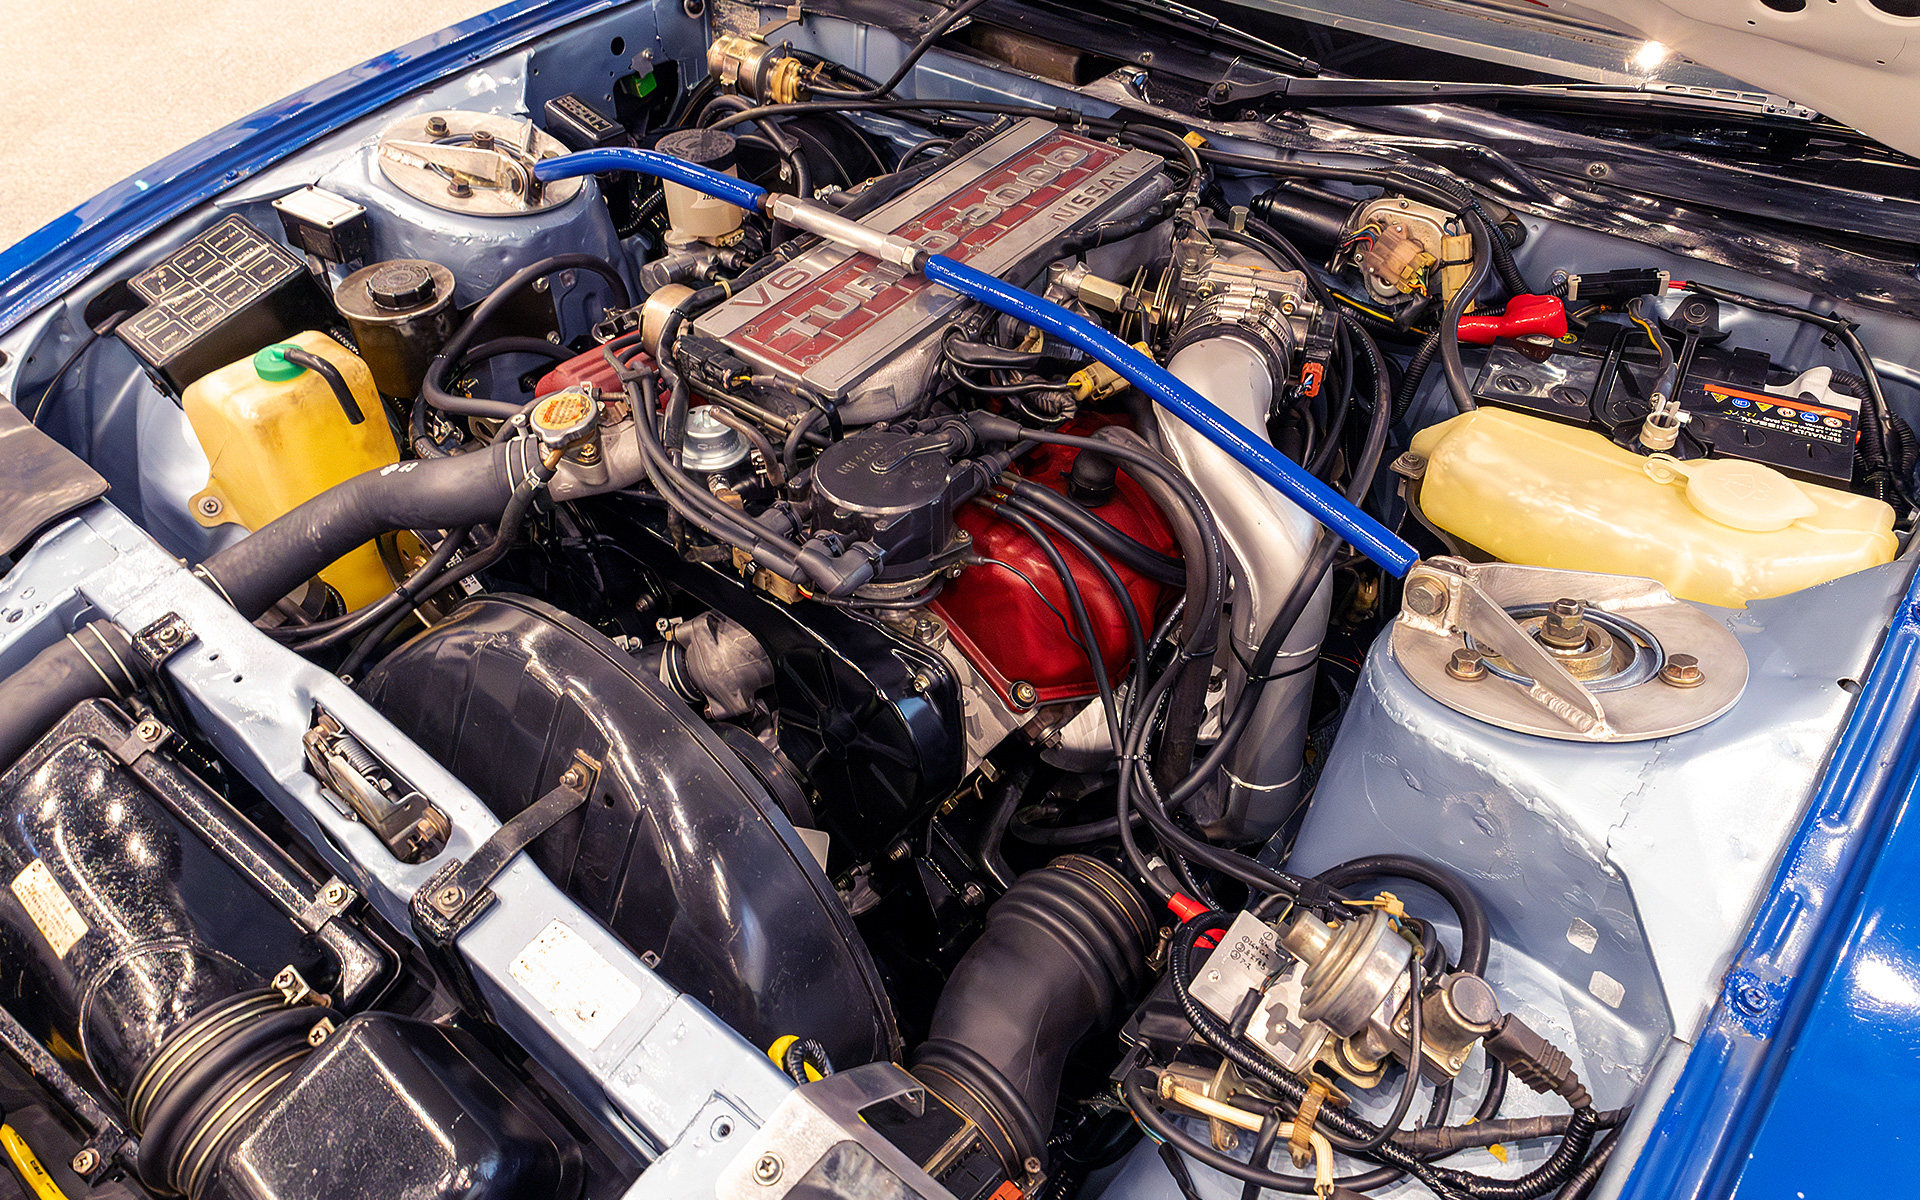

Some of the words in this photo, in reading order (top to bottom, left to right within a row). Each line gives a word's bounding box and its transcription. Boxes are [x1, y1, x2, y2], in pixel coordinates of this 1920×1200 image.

[1050, 166, 1141, 225] NISSAN
[729, 266, 813, 306] V6
[1739, 416, 1790, 432] NISSAN
[1791, 427, 1842, 443] RENAULT
